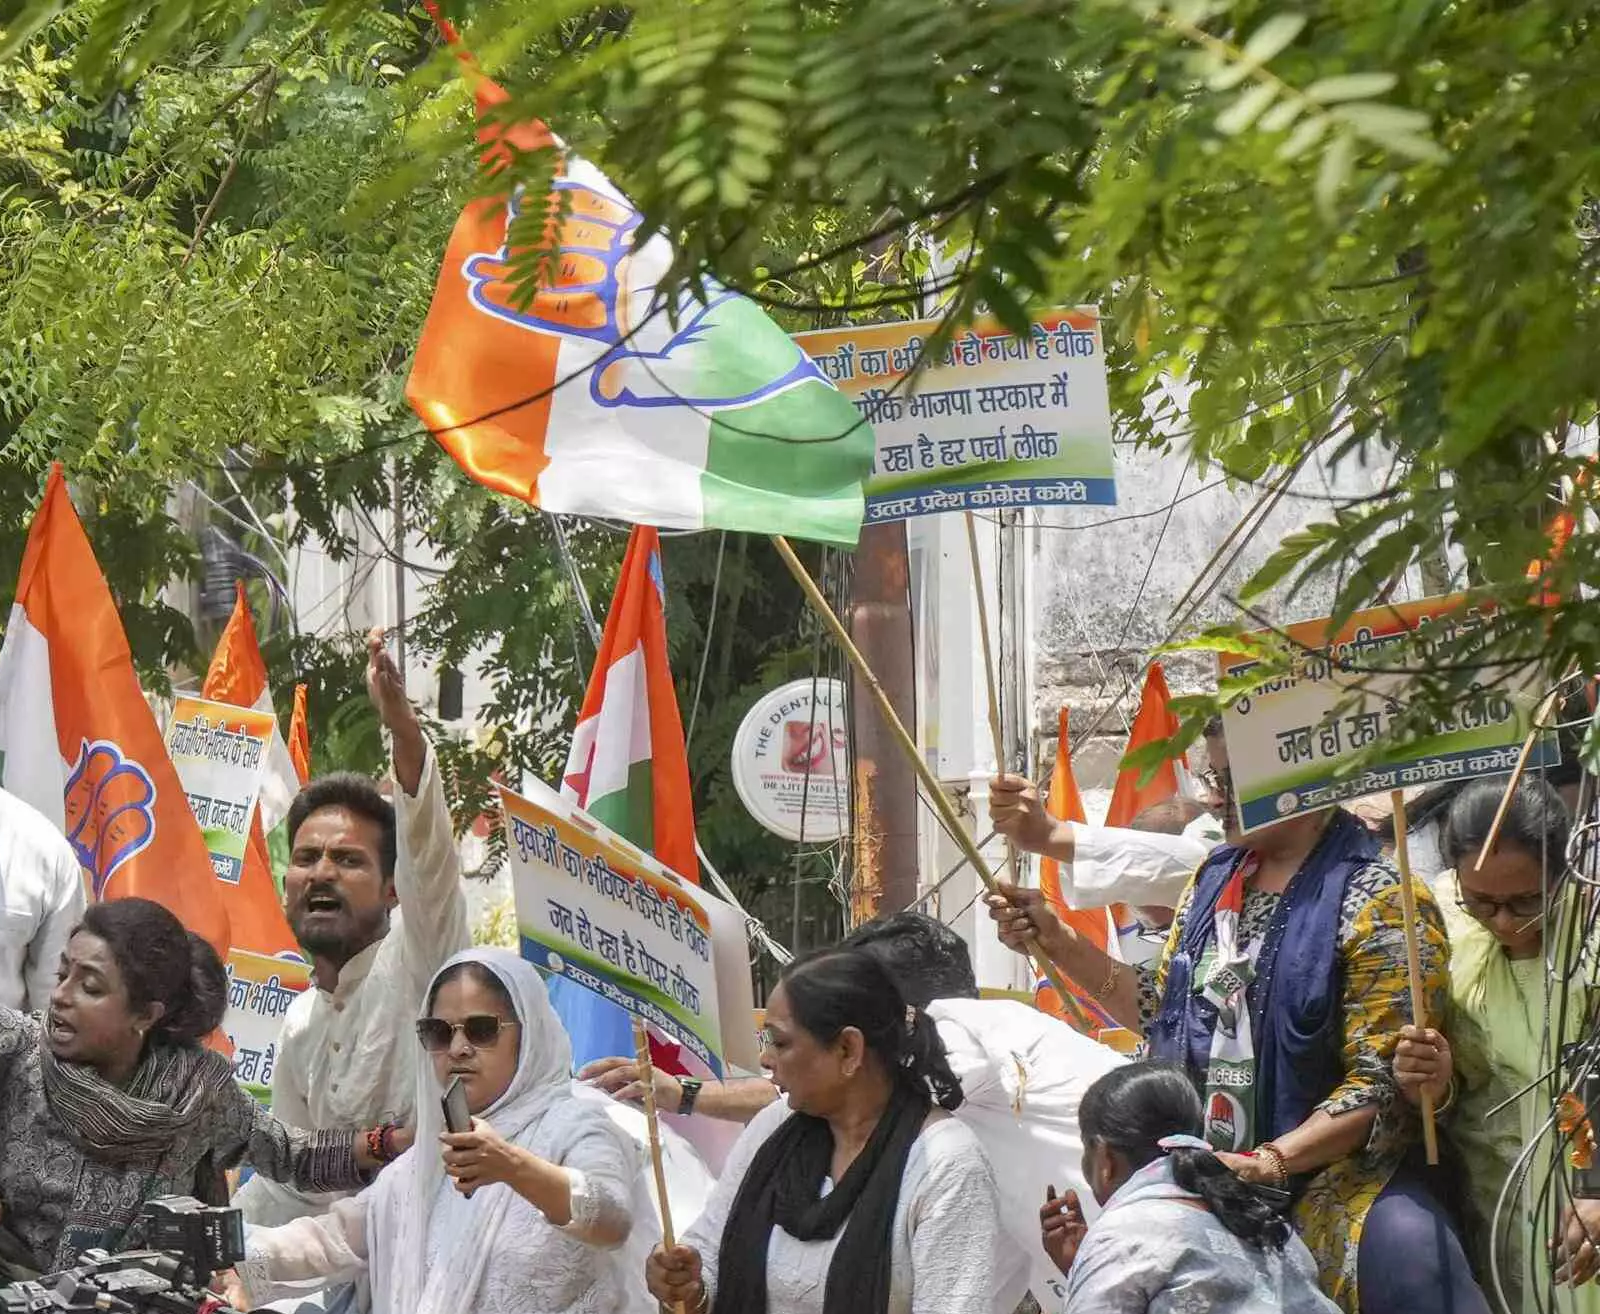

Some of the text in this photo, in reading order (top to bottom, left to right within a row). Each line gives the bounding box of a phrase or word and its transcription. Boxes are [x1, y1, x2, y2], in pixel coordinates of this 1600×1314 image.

[859, 350, 889, 375] का
[909, 390, 972, 419] भाजपा
[976, 381, 1046, 412] सरकार
[1049, 373, 1070, 408] में
[880, 444, 914, 472] रहा
[918, 434, 936, 468] है
[939, 438, 966, 465] हर
[969, 425, 1007, 461] पर्चा
[1012, 424, 1058, 459] लीक
[1034, 480, 1088, 503] कमेटी
[547, 899, 574, 940] जब
